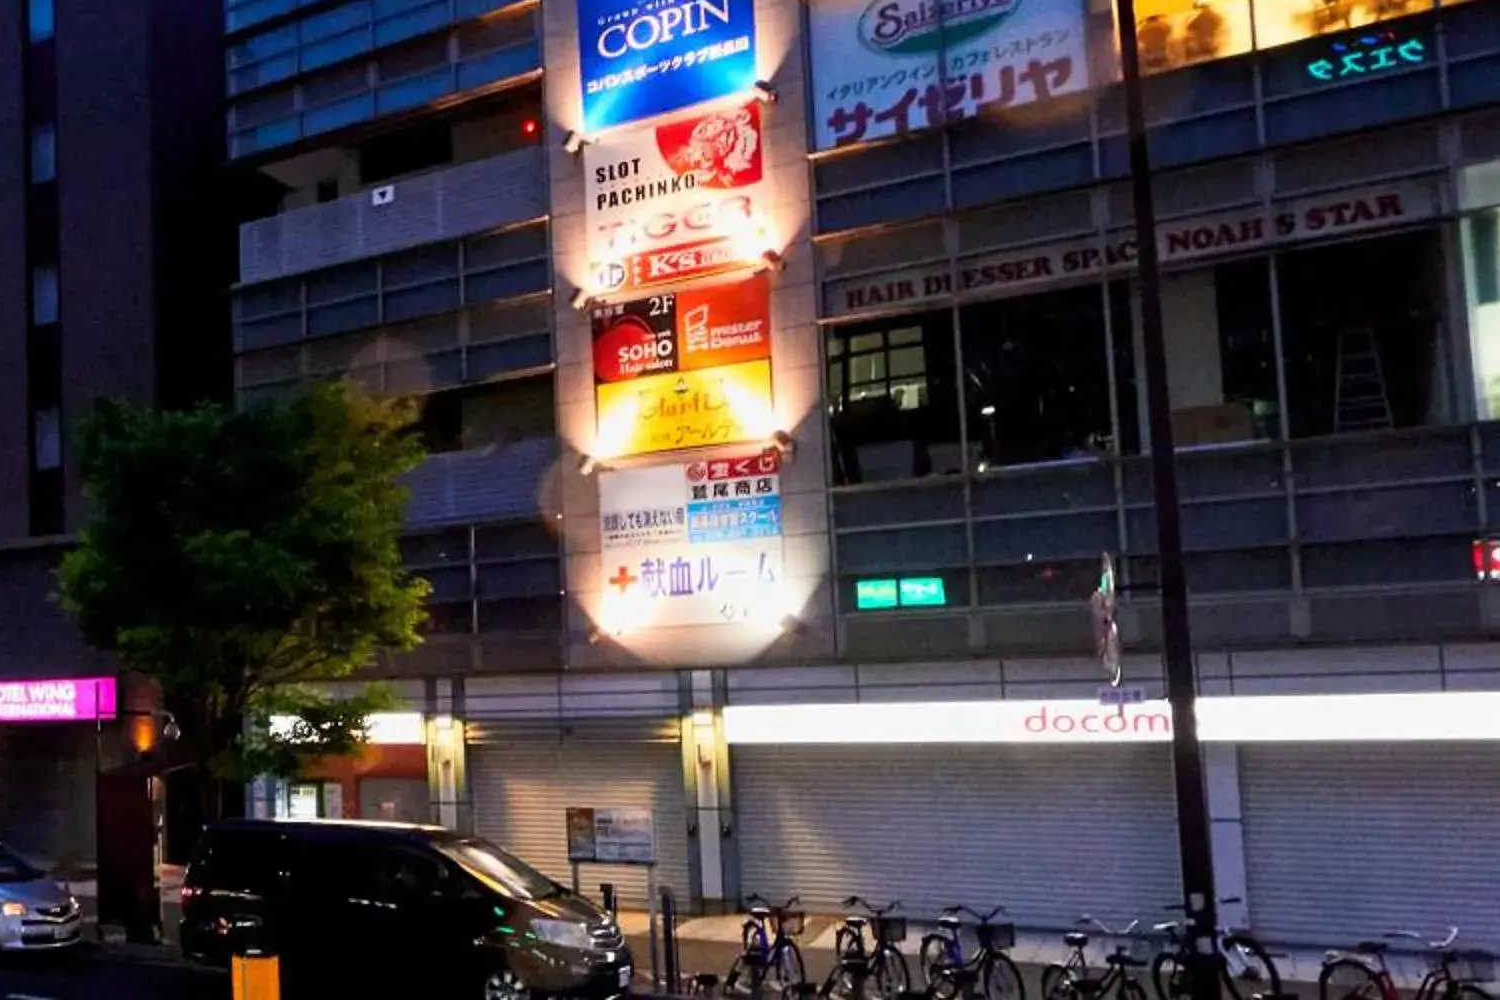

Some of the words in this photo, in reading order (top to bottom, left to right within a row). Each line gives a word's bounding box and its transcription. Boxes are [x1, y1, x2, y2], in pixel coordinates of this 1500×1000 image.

[827, 55, 1073, 144] サイゼリヤ
[595, 158, 642, 184] SLOT
[596, 173, 696, 211] PACHINKO
[845, 282, 916, 311] HAIR
[1061, 239, 1139, 271] SPAC
[1304, 192, 1404, 232] STAR
[649, 293, 675, 317] 2F
[617, 339, 673, 363] SOHO
[710, 455, 775, 479] 宝くじ
[640, 552, 774, 598] 献血ルーム
[1024, 705, 1171, 734] docom
